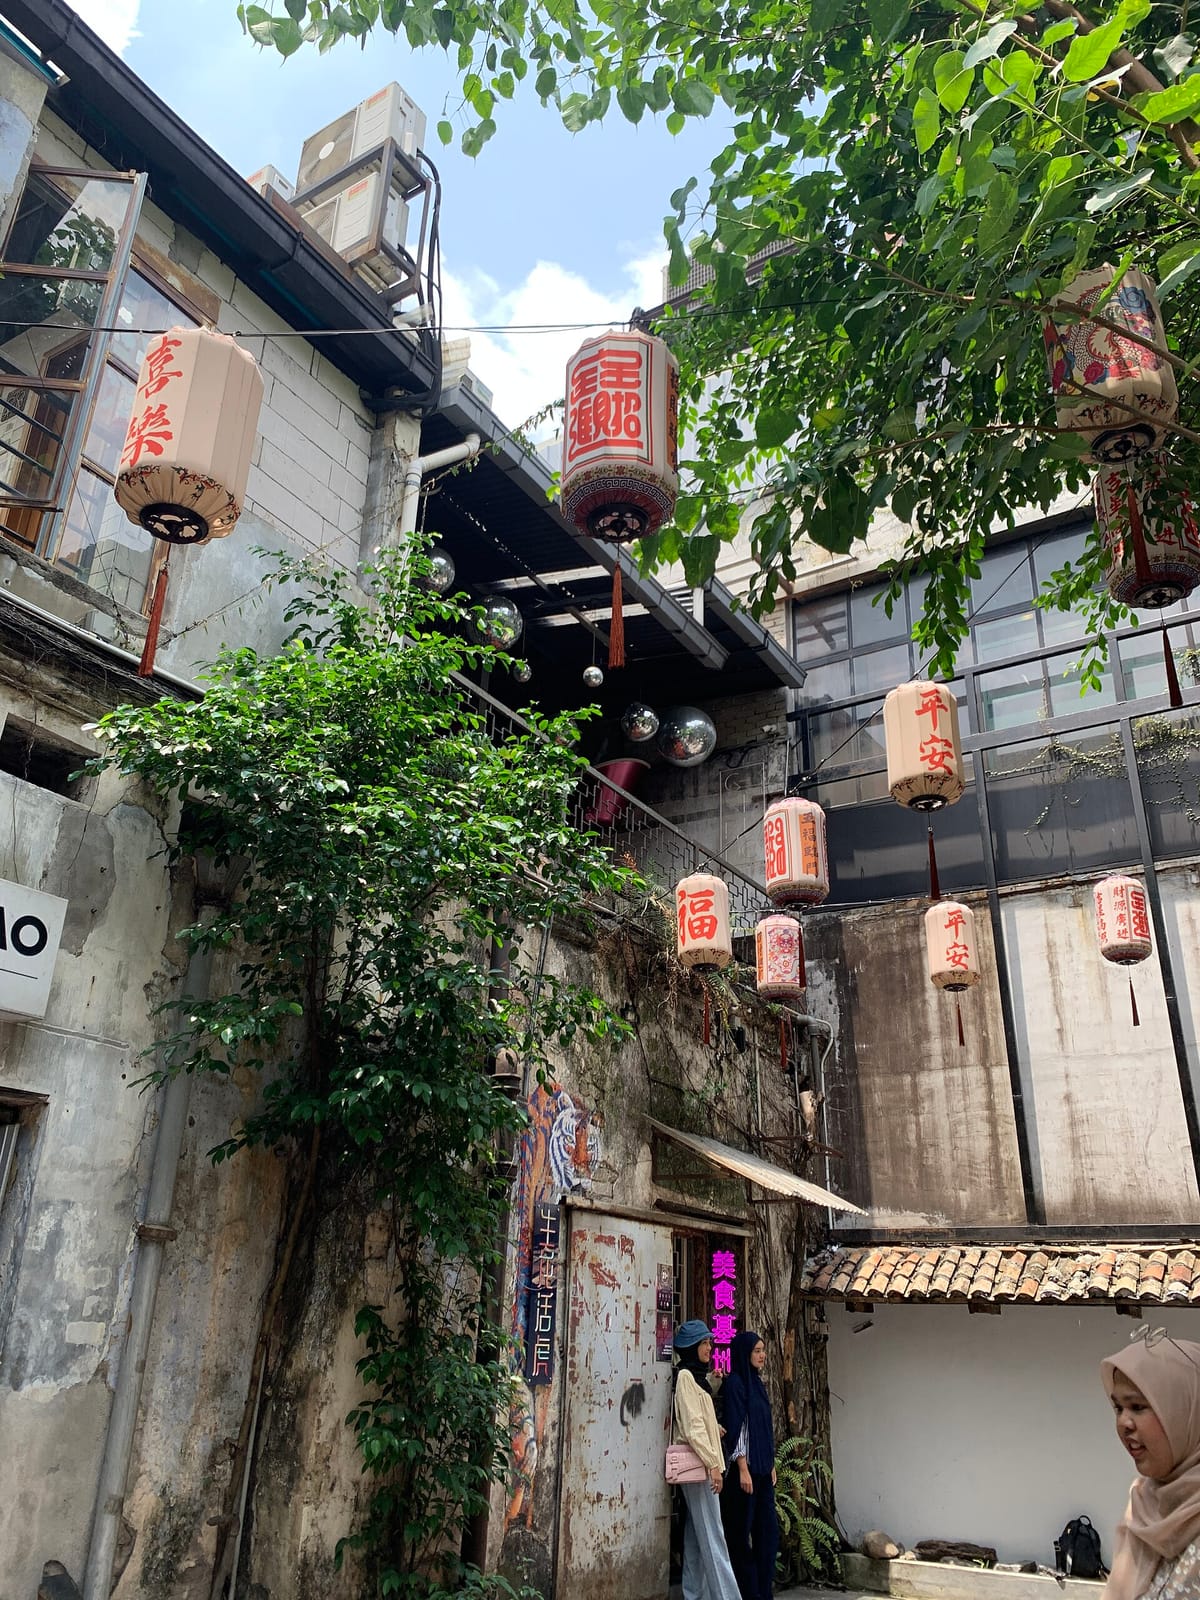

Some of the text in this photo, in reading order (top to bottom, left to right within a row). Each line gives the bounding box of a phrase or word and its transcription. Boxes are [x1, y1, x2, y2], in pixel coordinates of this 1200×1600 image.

[121, 336, 183, 467] 喜樂
[915, 688, 954, 776] 平安
[678, 889, 718, 946] 福
[944, 909, 970, 970] 平安
